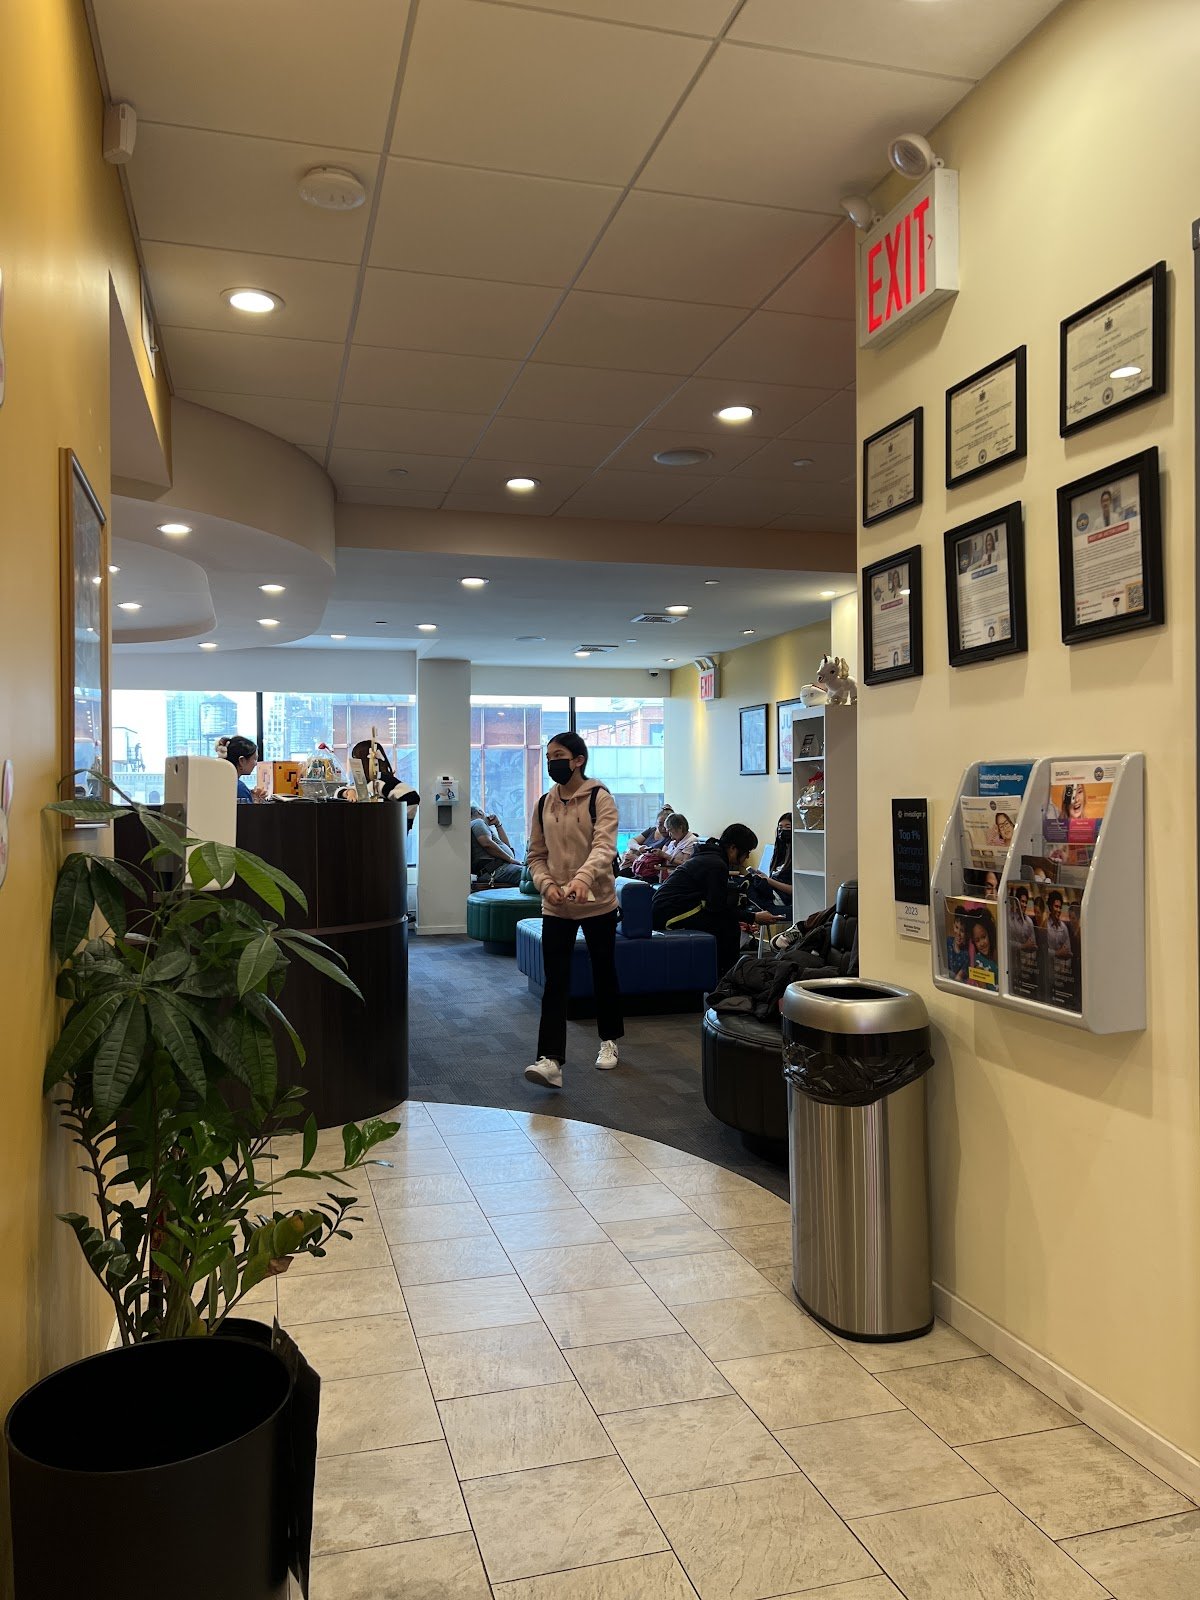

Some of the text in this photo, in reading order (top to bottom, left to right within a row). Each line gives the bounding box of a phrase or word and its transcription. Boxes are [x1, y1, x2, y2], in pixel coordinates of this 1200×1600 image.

[868, 196, 930, 334] EXIT
[701, 673, 713, 699] EXIT
[781, 714, 792, 730] JU
[899, 829, 911, 841] Top
[904, 905, 919, 916] 2023
